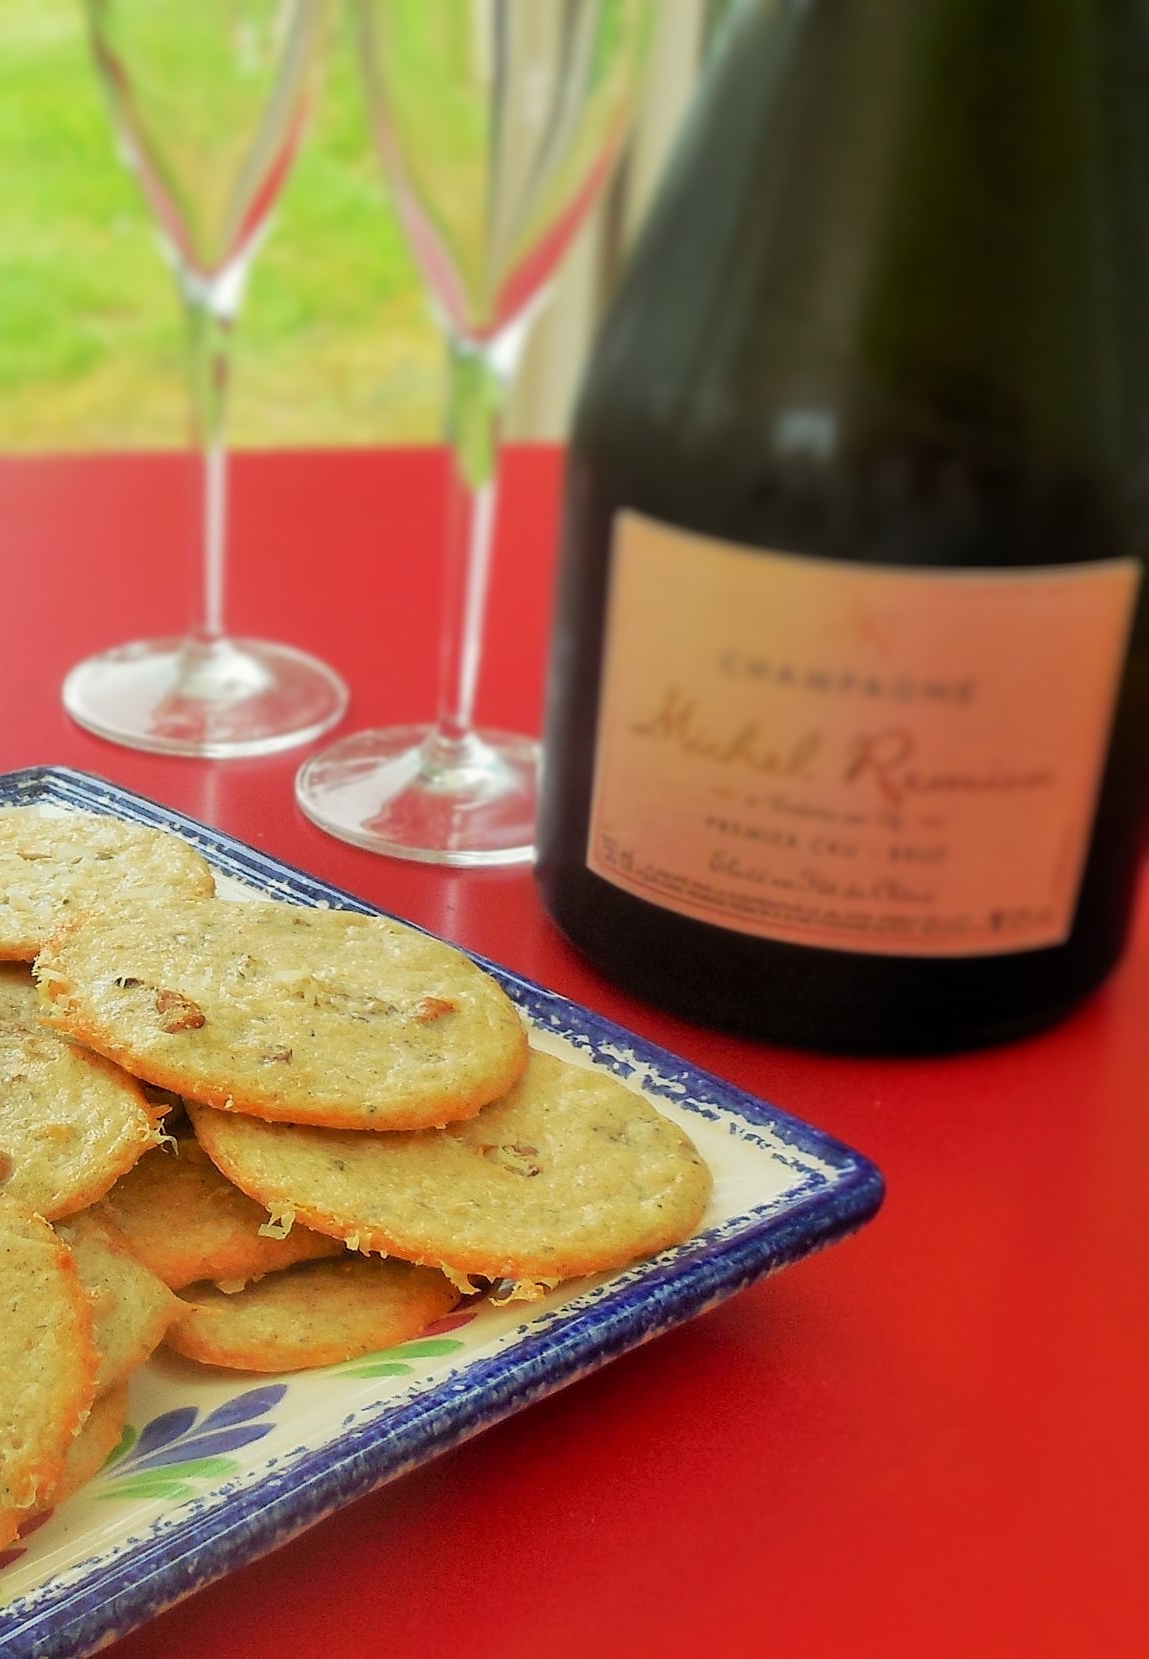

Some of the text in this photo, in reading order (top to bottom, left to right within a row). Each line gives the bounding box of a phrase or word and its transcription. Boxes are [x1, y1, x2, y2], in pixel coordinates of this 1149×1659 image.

[719, 651, 978, 705] CHAMPAGNE
[631, 685, 822, 783] Michel
[705, 814, 949, 865] PREMIER CRU BRUT
